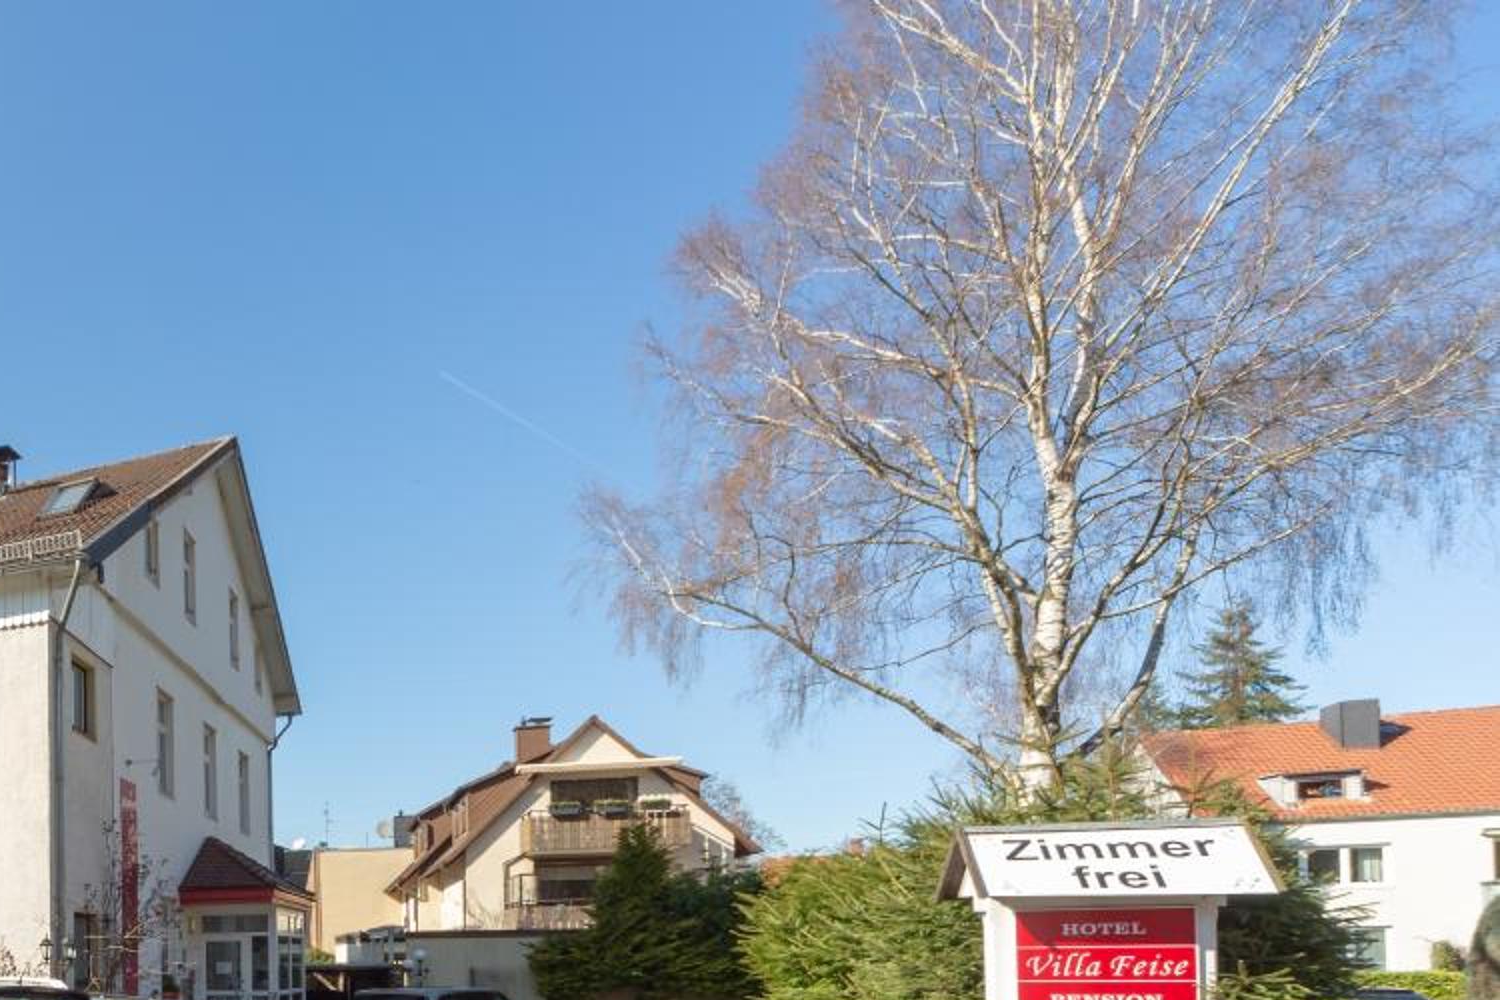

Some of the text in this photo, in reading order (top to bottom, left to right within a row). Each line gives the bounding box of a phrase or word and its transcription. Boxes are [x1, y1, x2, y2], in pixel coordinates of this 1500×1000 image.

[1002, 839, 1215, 861] Zimmer
[1072, 865, 1167, 889] frei
[1060, 922, 1147, 936] HOTEL
[1026, 952, 1189, 977] Villa Feise
